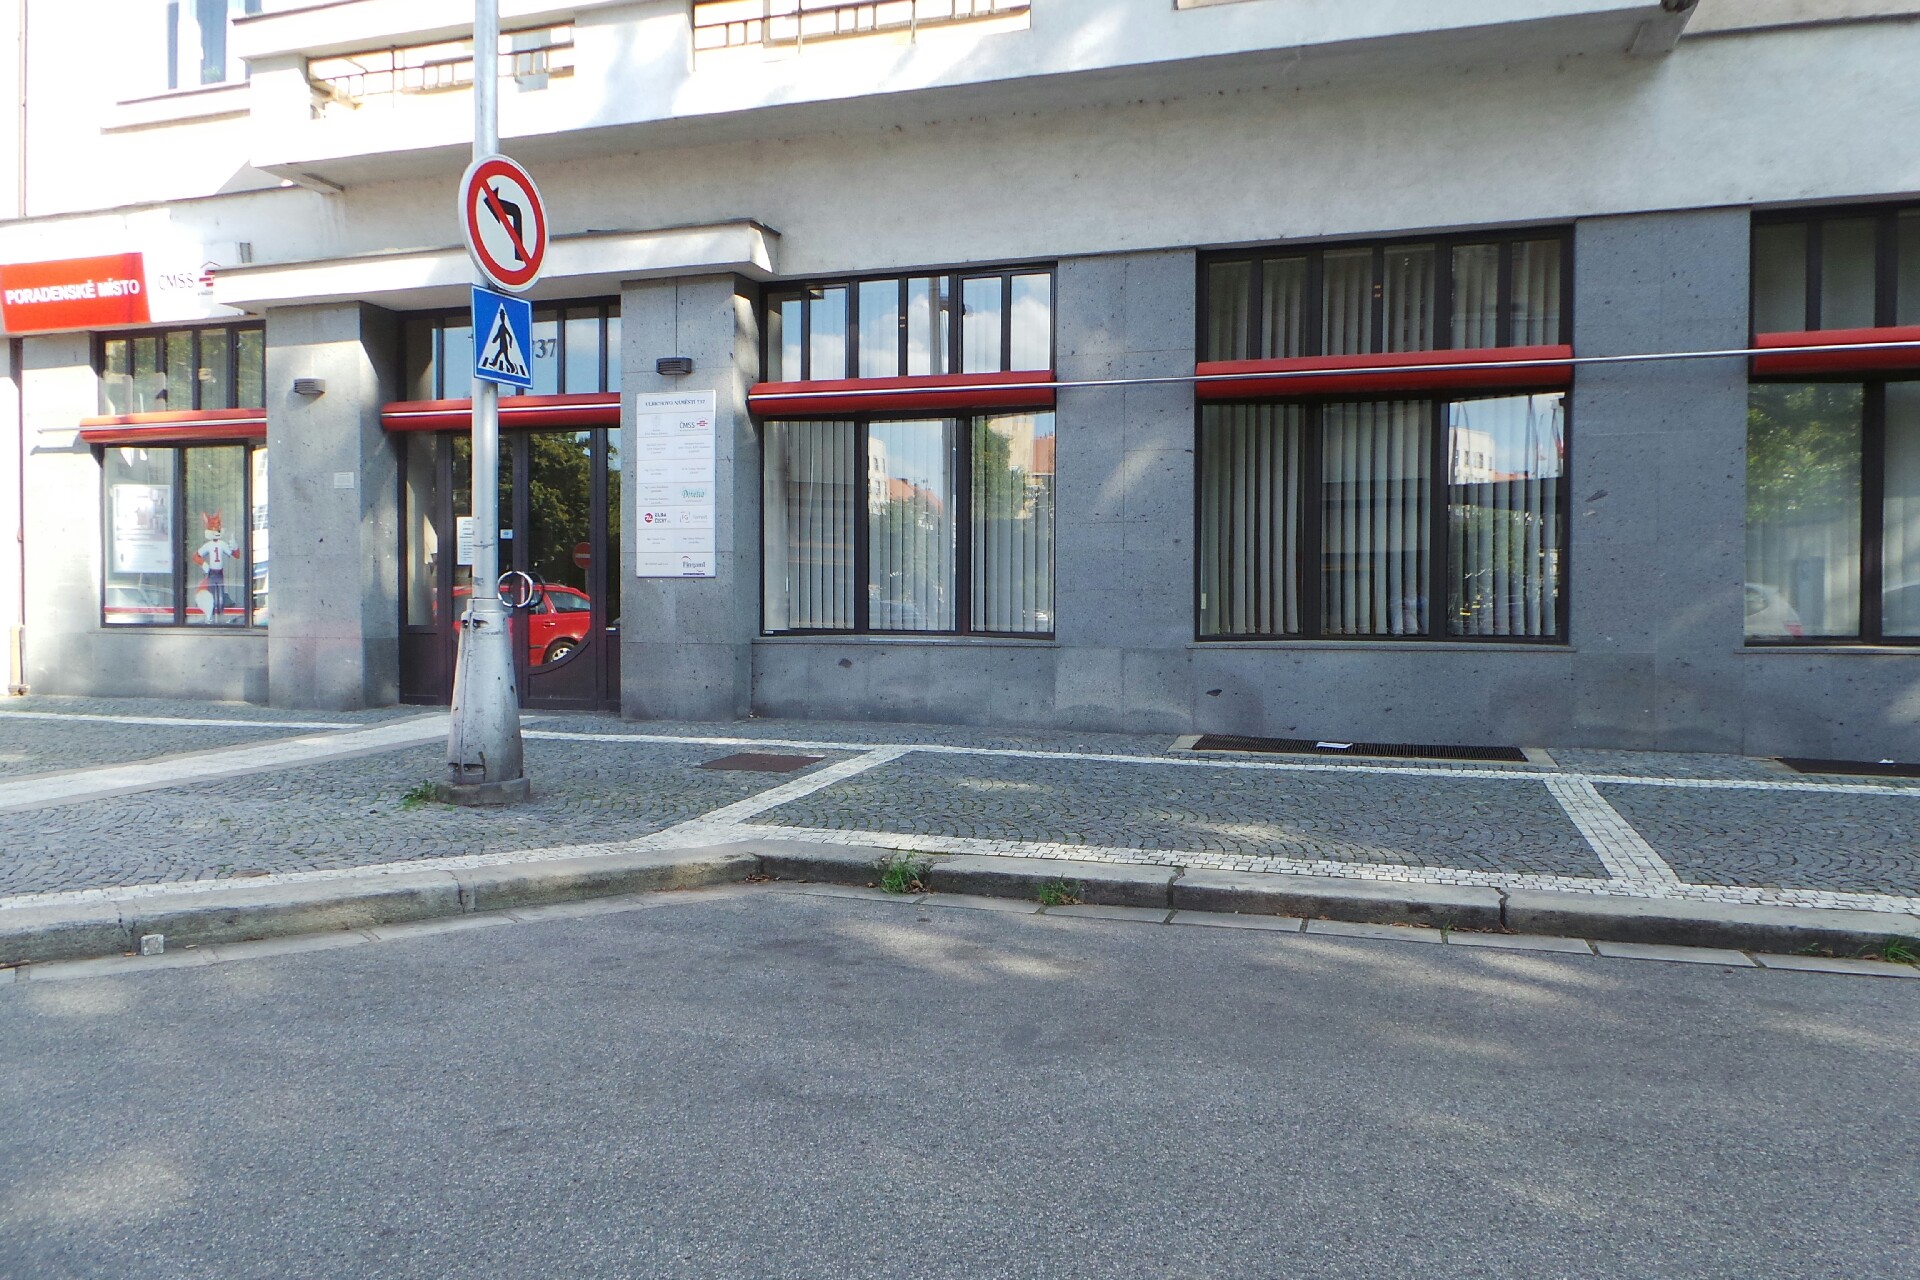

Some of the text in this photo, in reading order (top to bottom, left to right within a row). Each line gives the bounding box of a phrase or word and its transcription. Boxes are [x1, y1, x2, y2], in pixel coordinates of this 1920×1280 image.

[5, 277, 140, 305] PORADENSKÉ MÍSTO
[214, 546, 221, 563] 1
